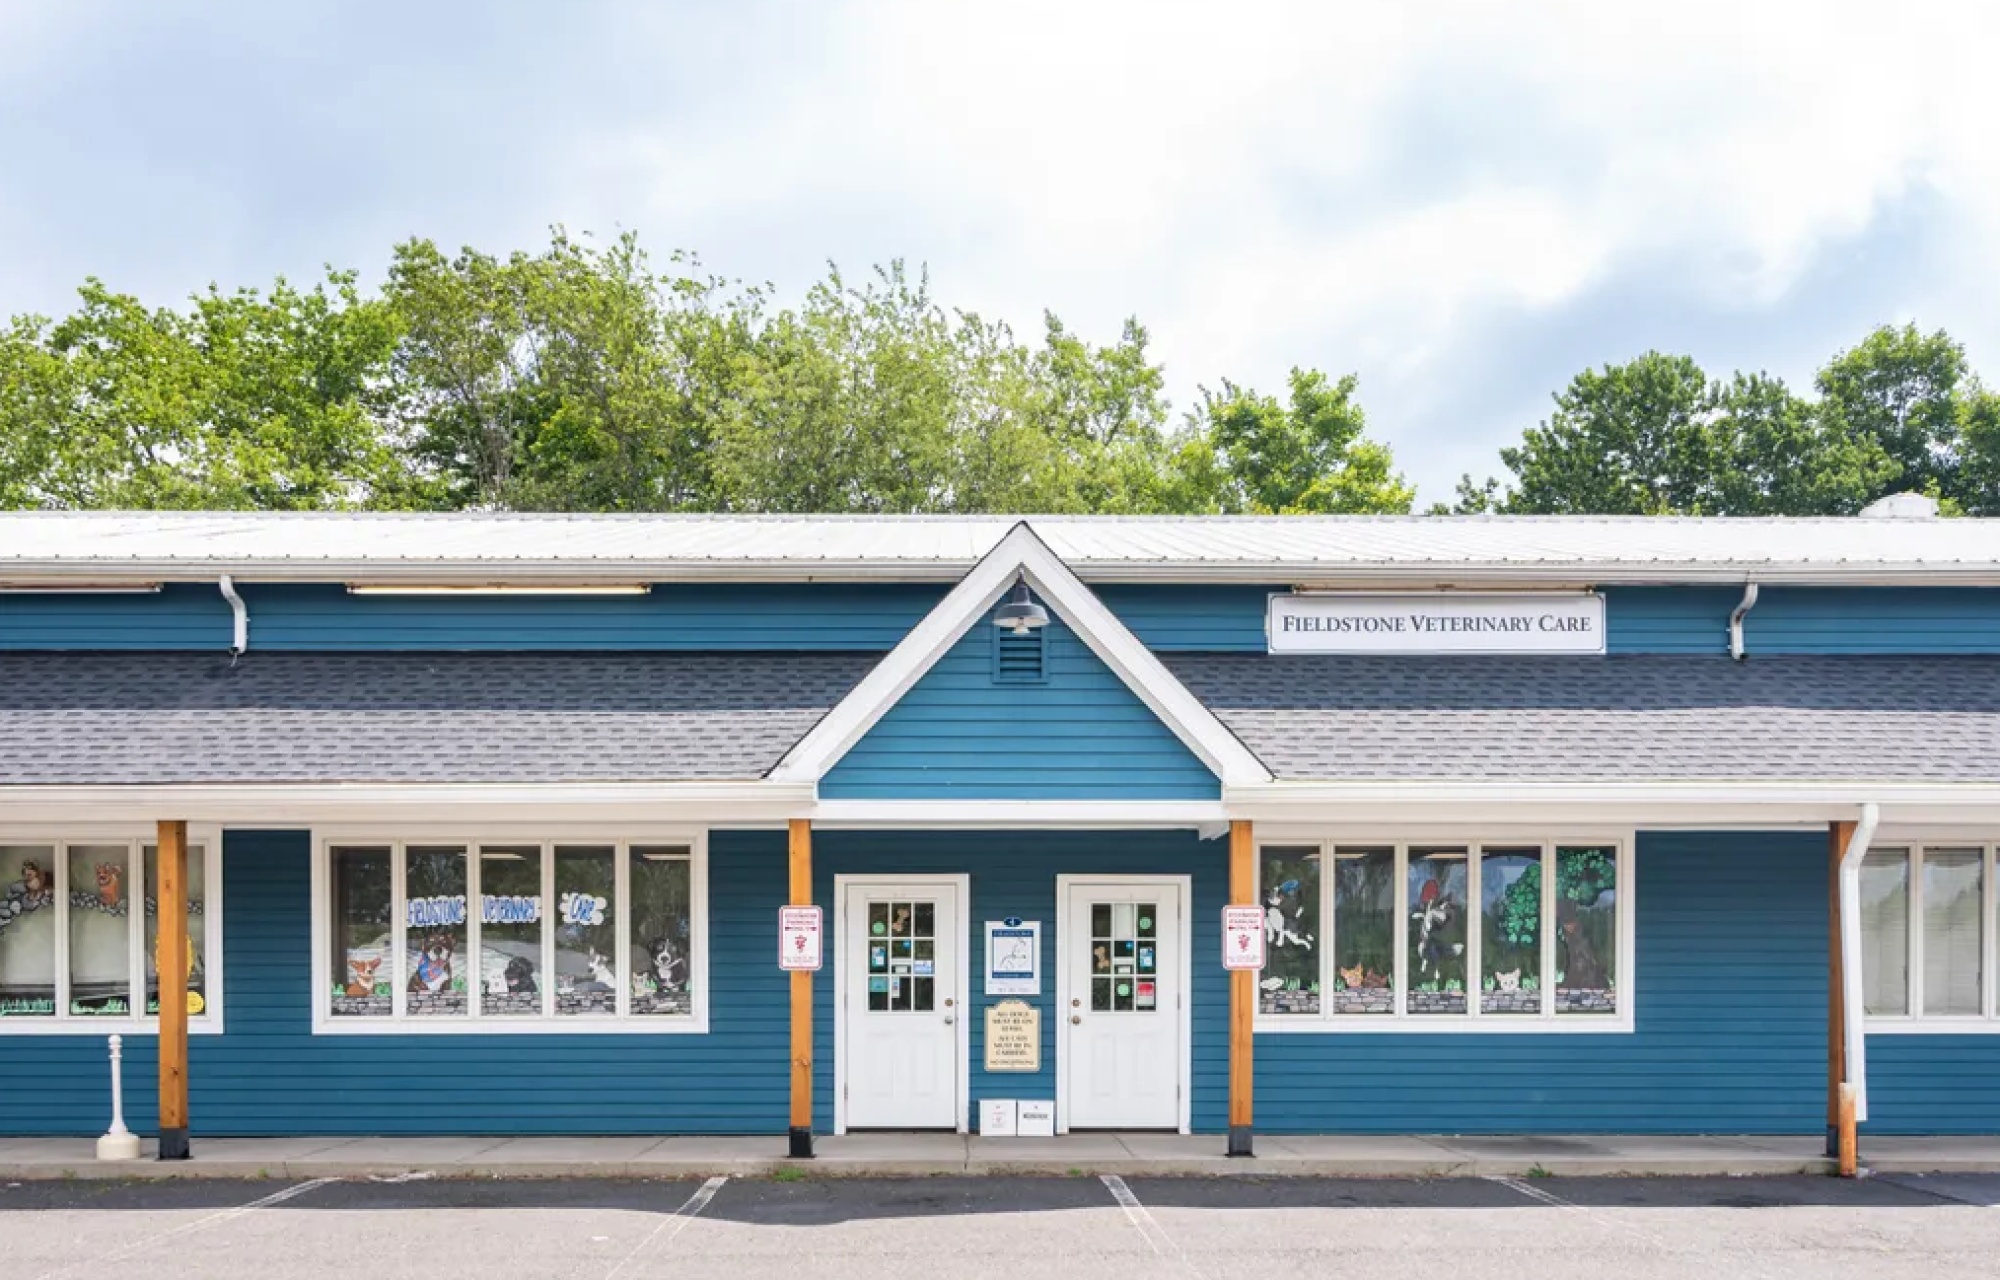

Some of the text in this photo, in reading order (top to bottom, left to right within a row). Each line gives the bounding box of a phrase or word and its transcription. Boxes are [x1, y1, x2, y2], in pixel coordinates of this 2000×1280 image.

[1282, 614, 1592, 632] FIELDSTONE VETERINARY CARE
